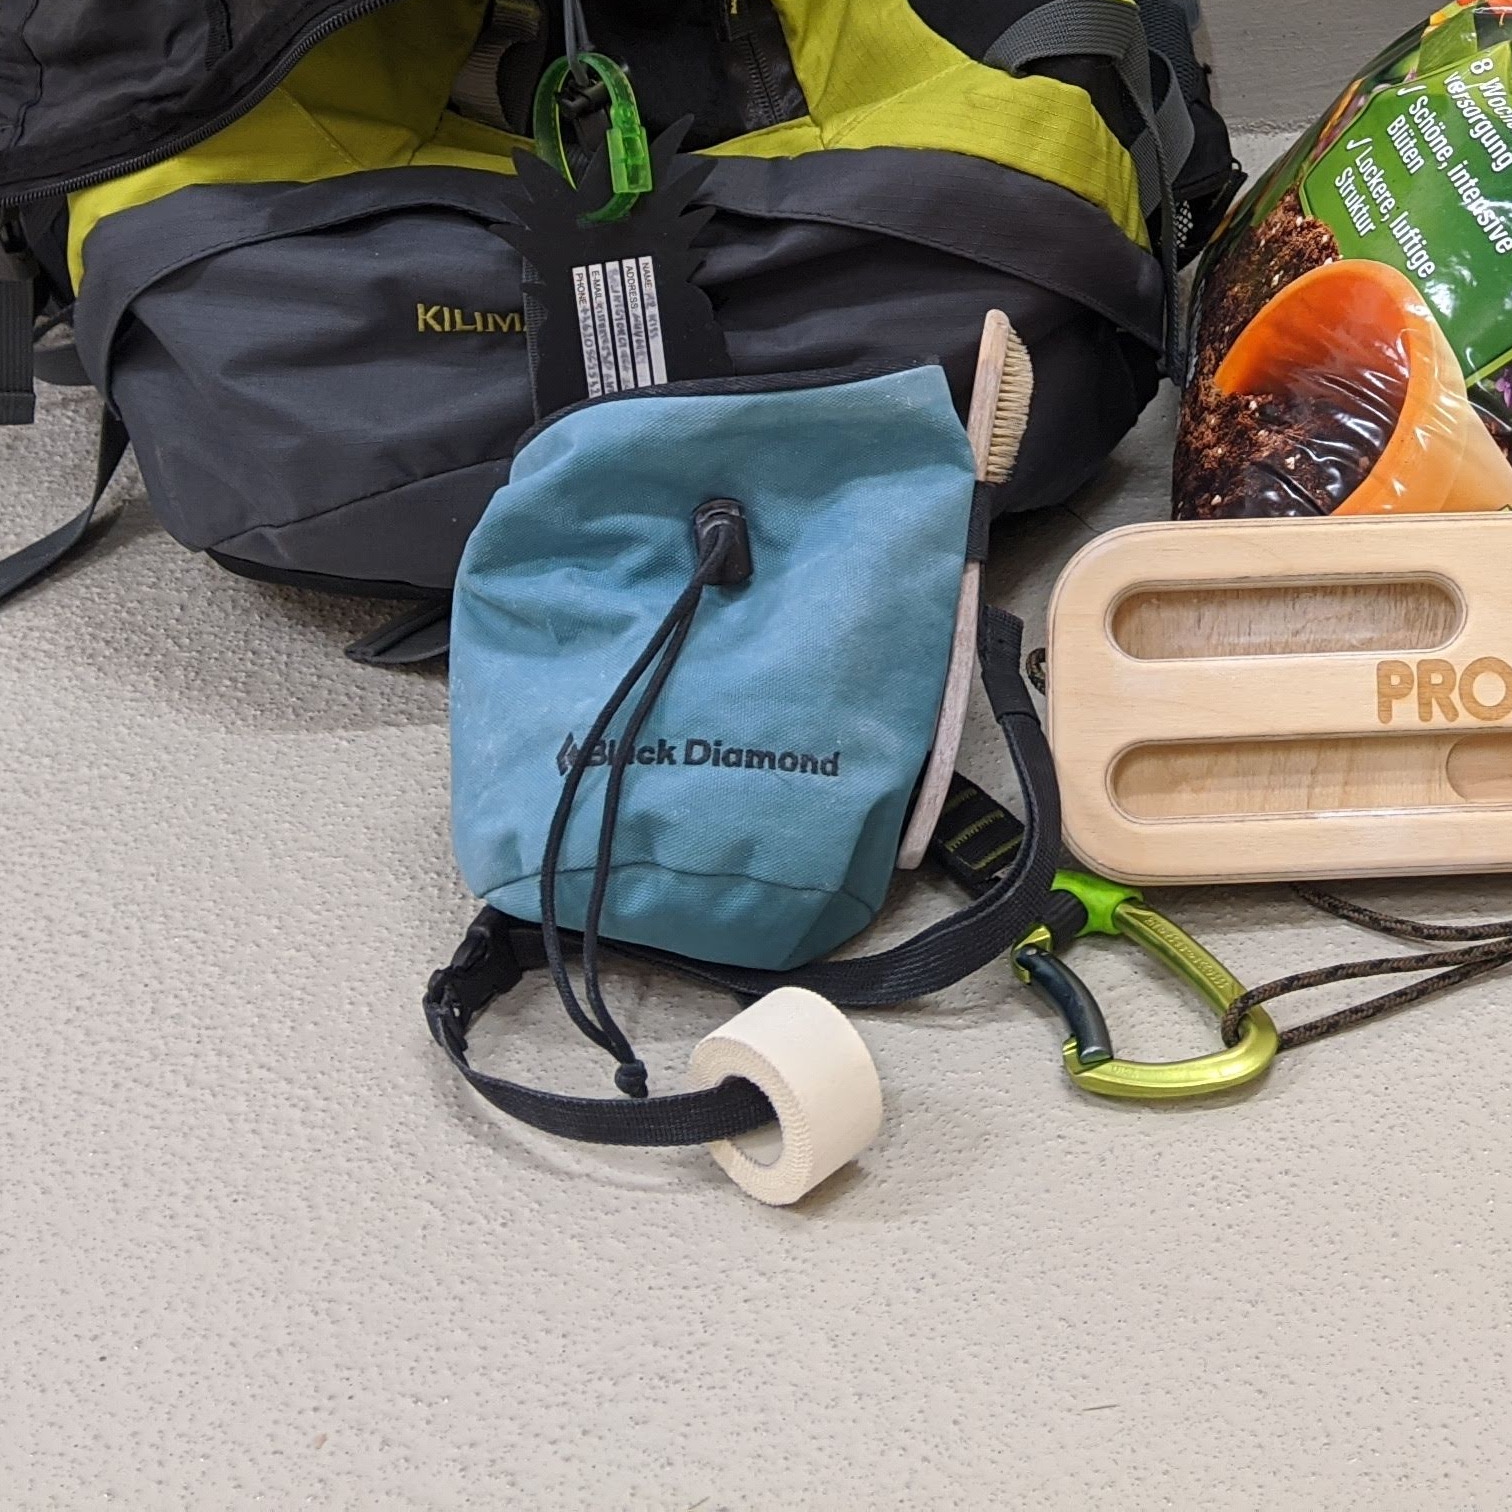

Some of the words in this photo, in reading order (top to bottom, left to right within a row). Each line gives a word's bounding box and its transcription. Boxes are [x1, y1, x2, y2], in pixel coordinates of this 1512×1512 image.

[1470, 58, 1494, 75] 8
[1387, 115, 1425, 174] Blüten
[1409, 95, 1453, 170] Schöne,
[1335, 166, 1376, 237] Struktur
[1355, 146, 1396, 222] Lockere,
[1389, 211, 1436, 278] luftige
[684, 738, 840, 777] Diamond
